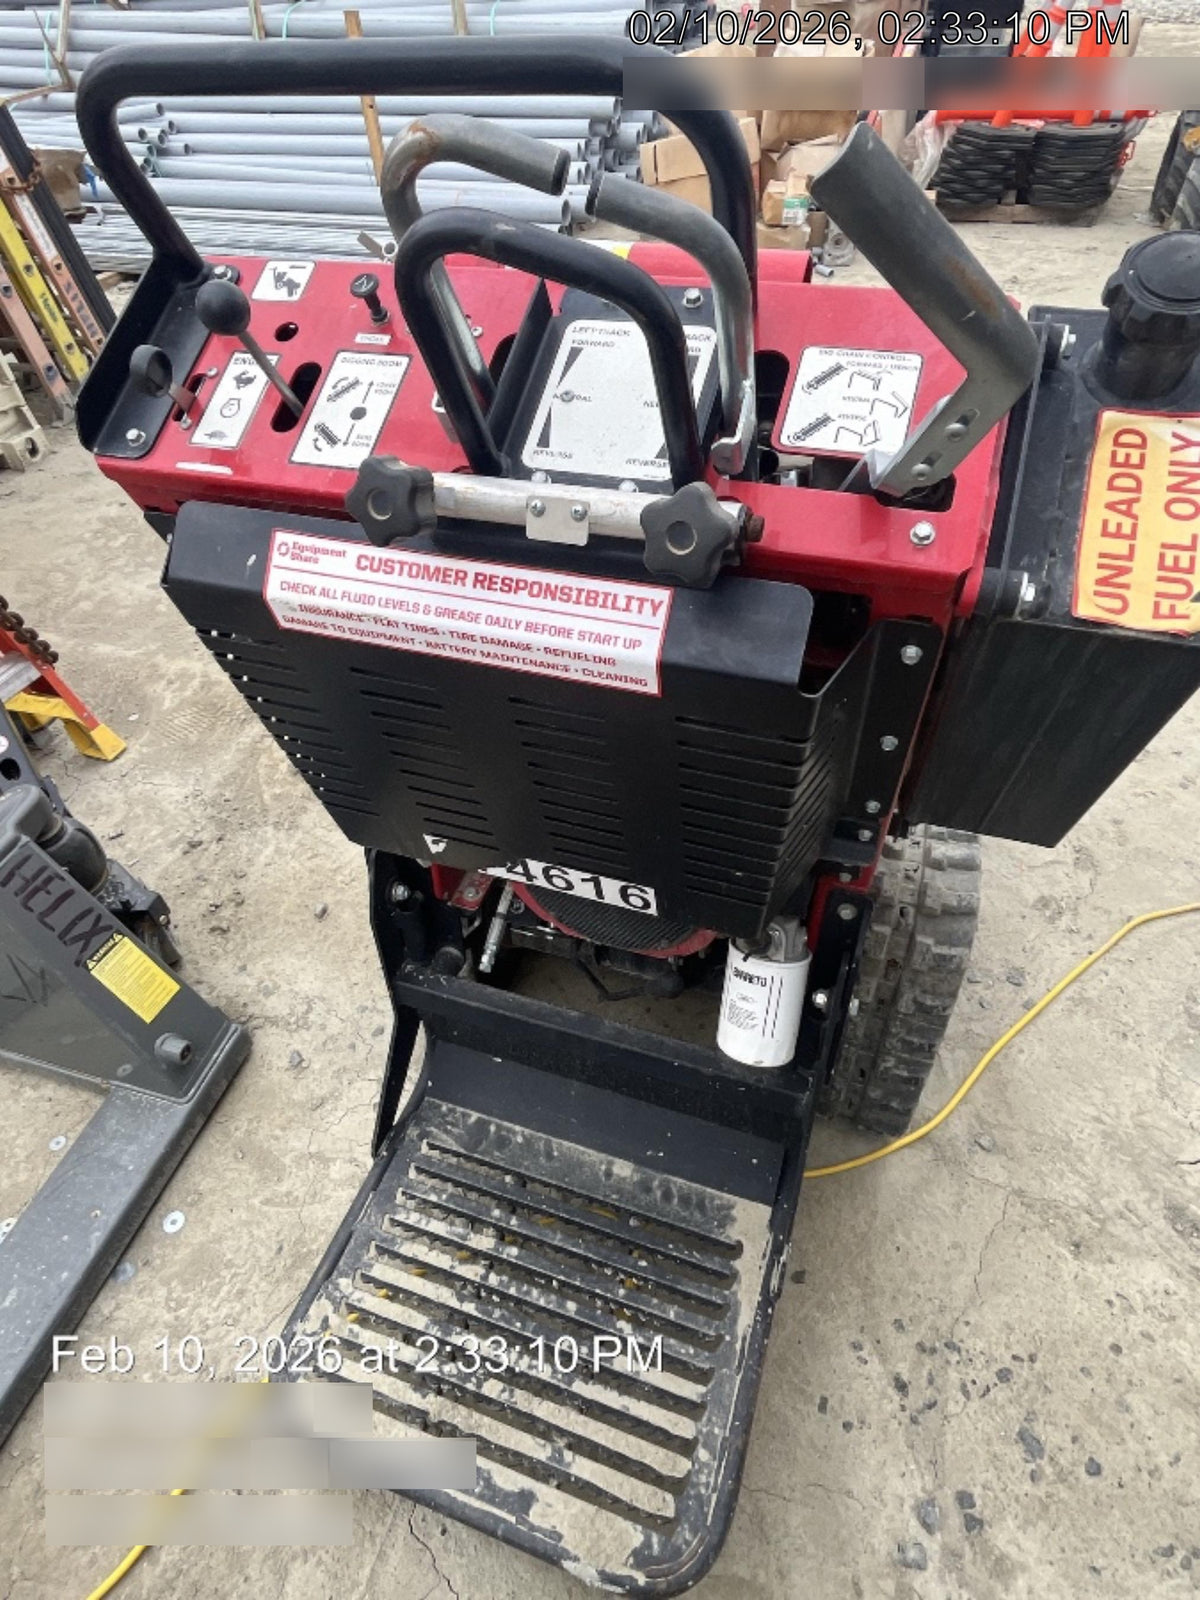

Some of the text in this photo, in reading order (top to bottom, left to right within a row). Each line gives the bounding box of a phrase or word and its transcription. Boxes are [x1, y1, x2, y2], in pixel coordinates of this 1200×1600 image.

[685, 333, 712, 342] RACK
[291, 541, 347, 558] Equipment
[1093, 427, 1148, 616] UNLEADED
[1152, 431, 1200, 620] FUEL ONLY
[290, 552, 320, 565] Share
[355, 553, 664, 618] CUSTOMER RESPONSIBILITY
[280, 580, 643, 651] CHECK ALL FLUID LEVELS & GREASE DAILY BEFORE START UP
[373, 615, 399, 630] FLAT
[447, 630, 477, 643] TIRE
[479, 635, 533, 653] DAMAGE
[543, 646, 617, 667] REFUELING
[282, 614, 648, 687] DAMAGE TO EQUIPMENT BATTERY MAINTENANCE CLEANING
[1, 853, 114, 968] HELIX
[506, 858, 651, 911] 4616
